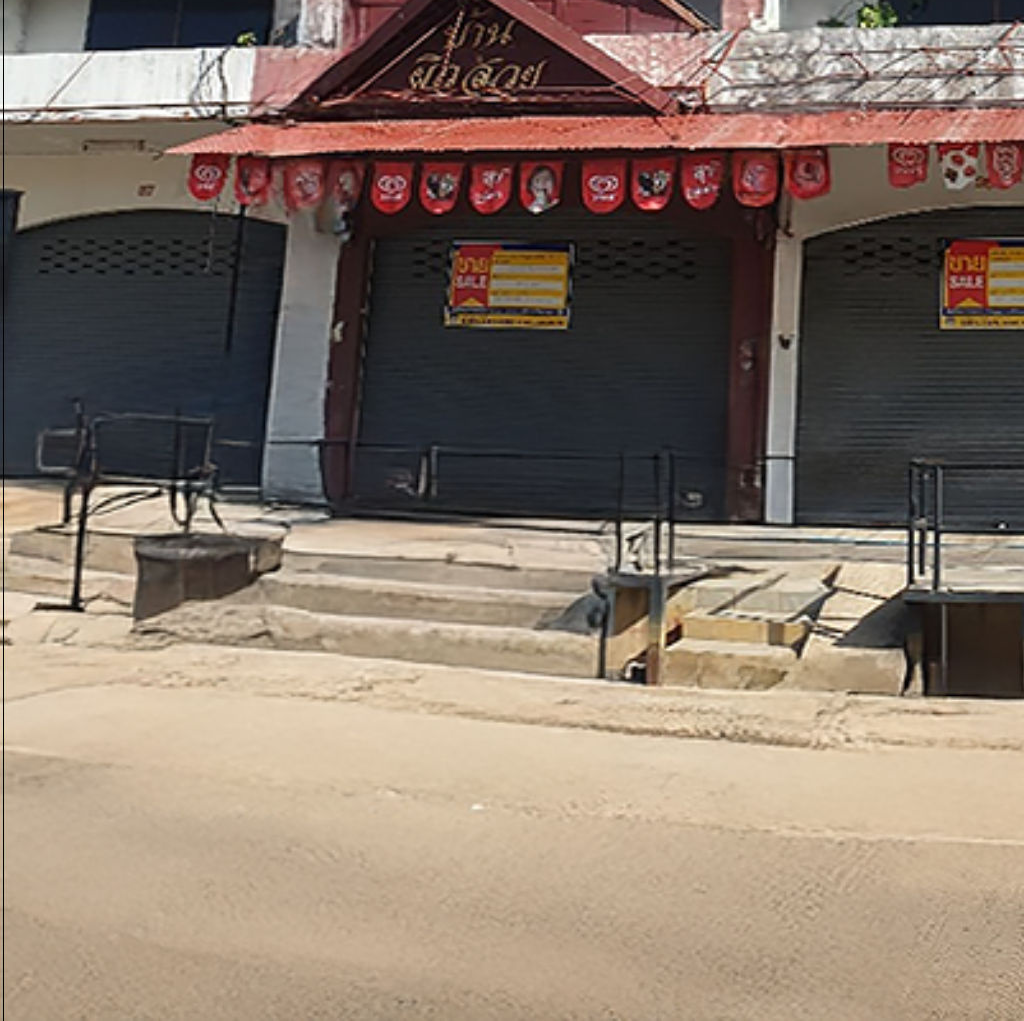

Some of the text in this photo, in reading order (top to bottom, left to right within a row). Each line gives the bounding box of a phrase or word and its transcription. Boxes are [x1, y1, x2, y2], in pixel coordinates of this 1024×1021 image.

[948, 256, 986, 273] ขาย
[454, 275, 487, 289] SALE
[949, 275, 985, 289] SALE
